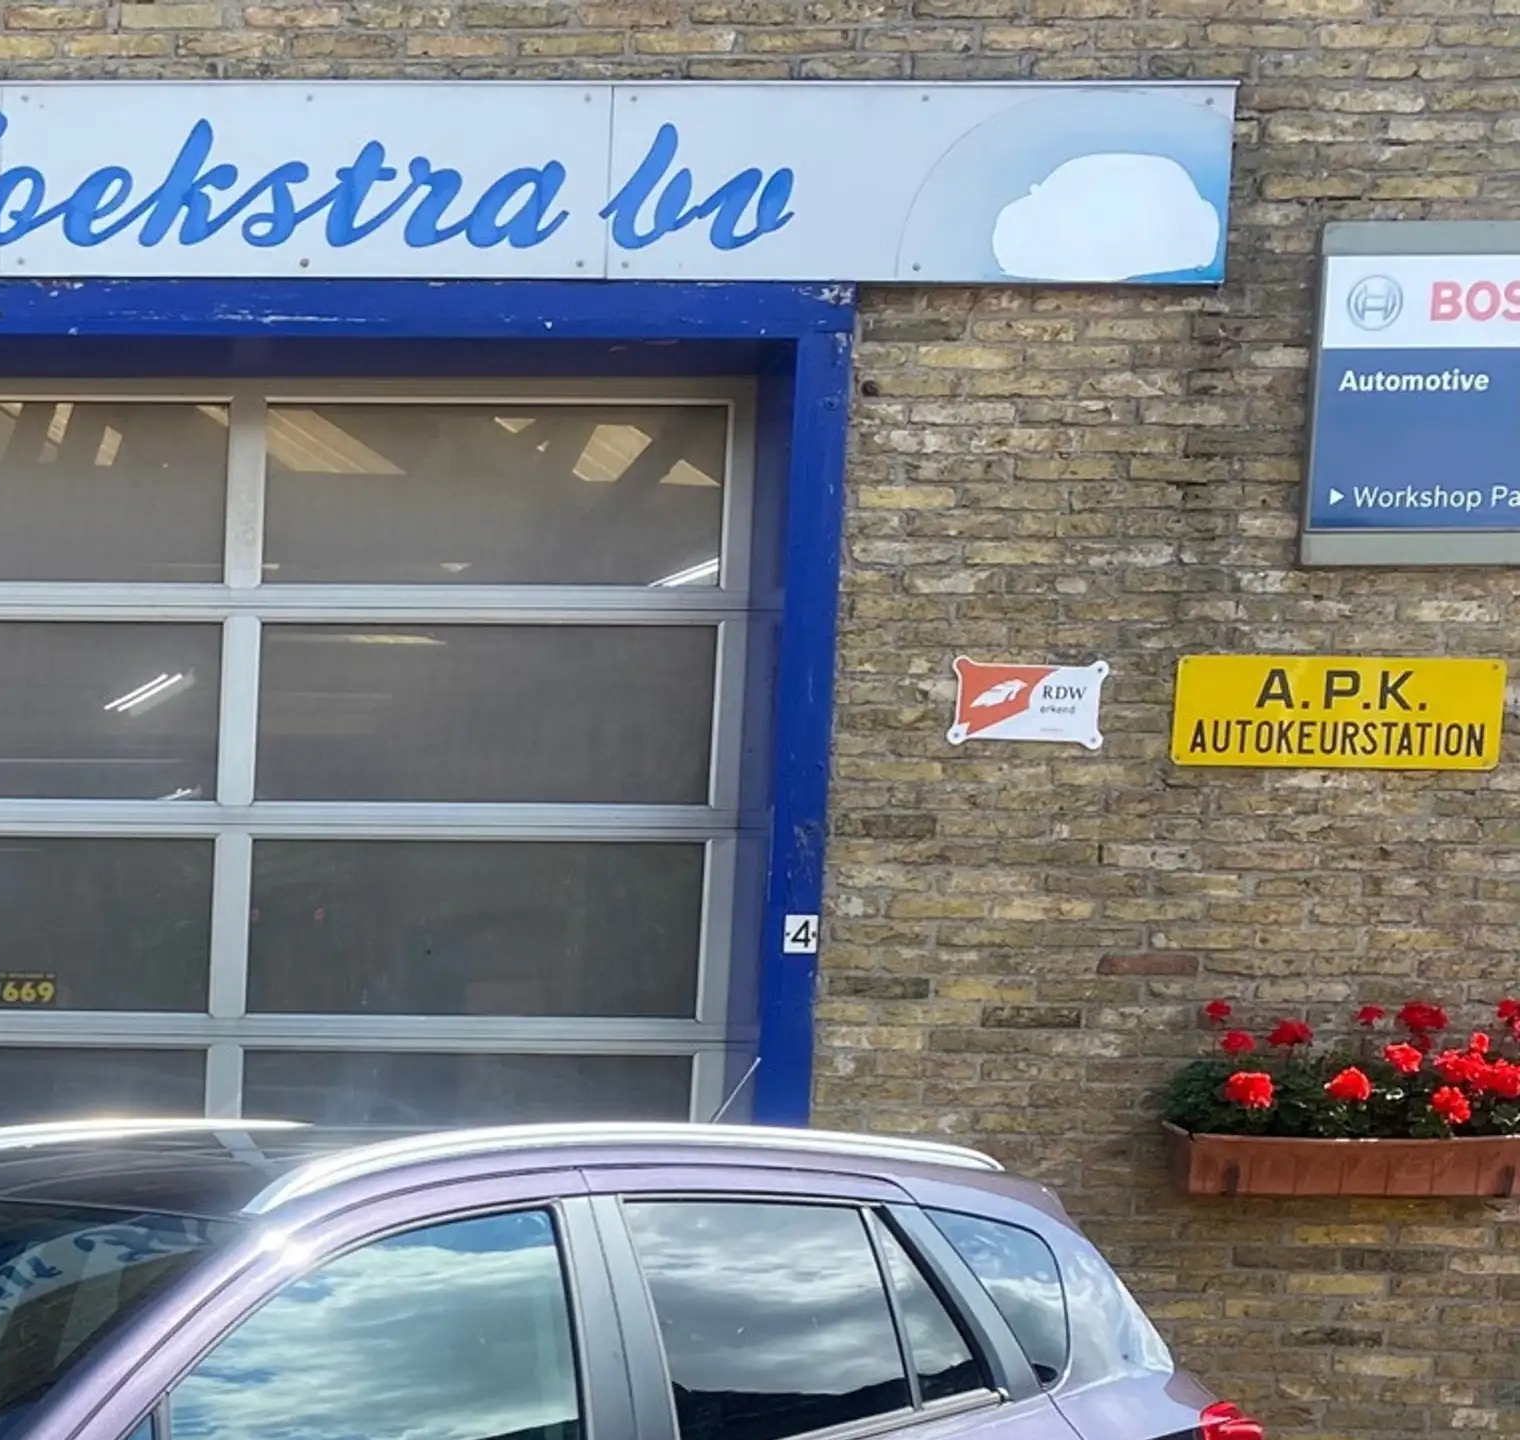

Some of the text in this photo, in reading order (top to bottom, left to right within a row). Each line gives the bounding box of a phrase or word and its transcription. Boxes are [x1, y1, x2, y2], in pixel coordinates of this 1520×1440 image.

[601, 122, 796, 252] bv
[1338, 368, 1490, 393] Automotive
[1354, 484, 1482, 512] Workshop
[1042, 684, 1088, 701] RDW
[1256, 668, 1429, 711] A.P.K.
[1040, 704, 1076, 716] erkend
[1189, 718, 1486, 758] AUTOKEURSTATION
[791, 919, 812, 948] 4
[2, 981, 55, 1002] 669
